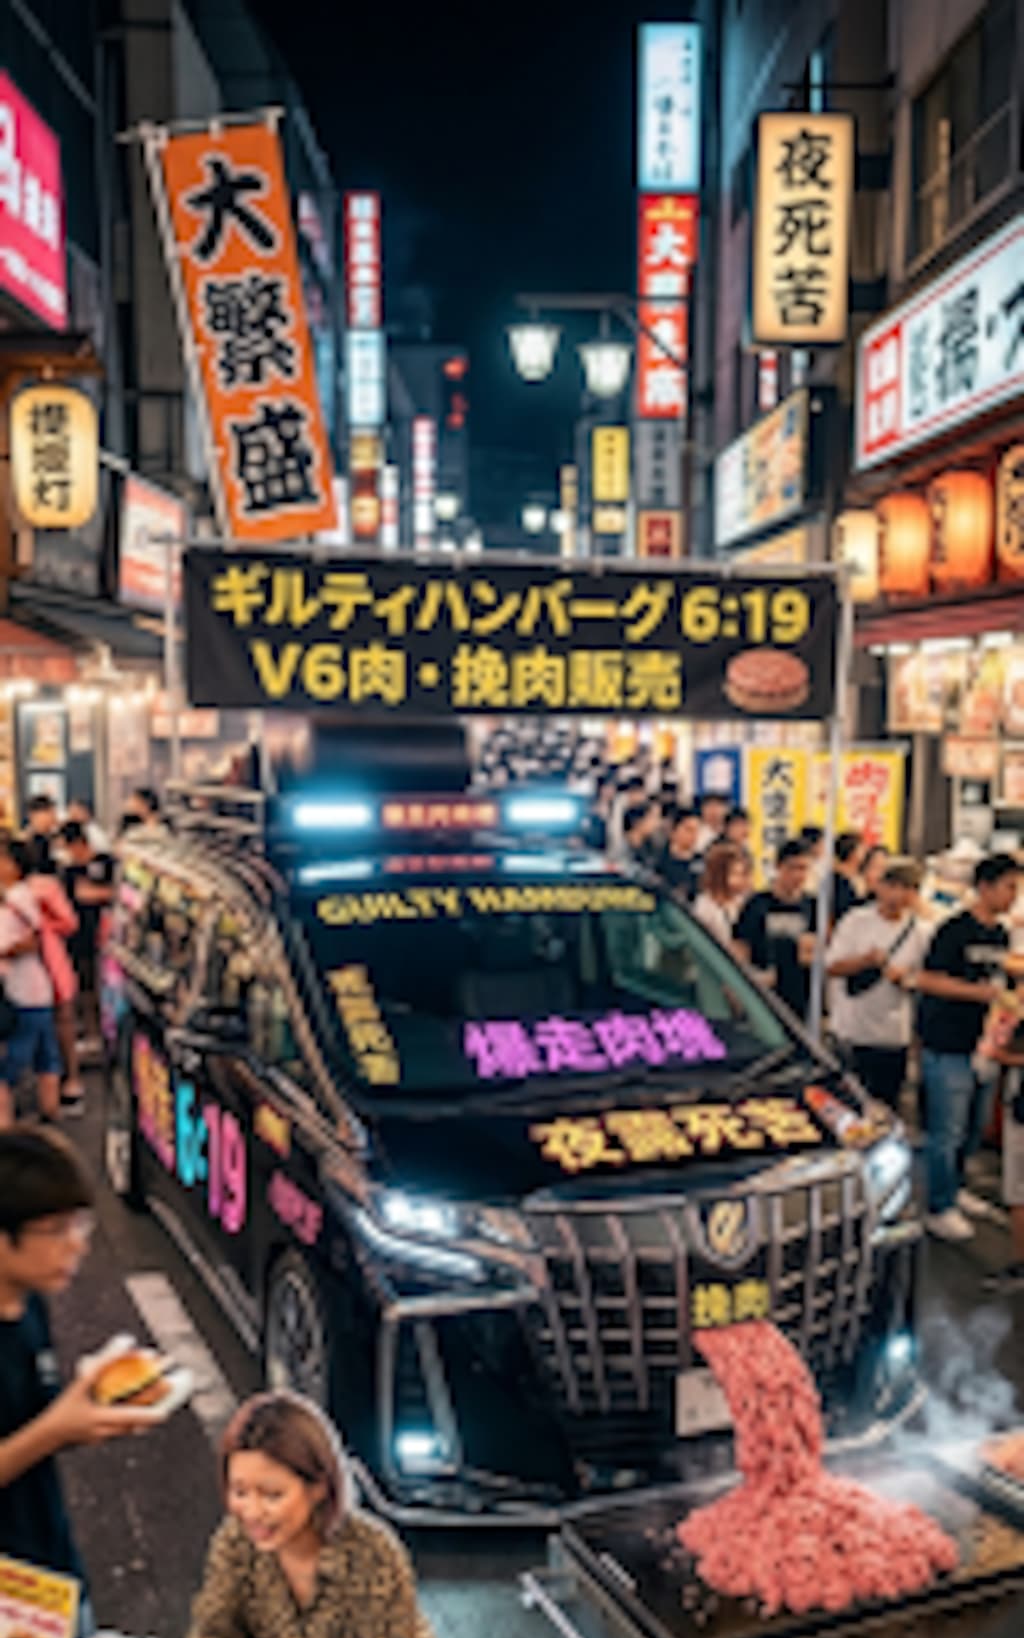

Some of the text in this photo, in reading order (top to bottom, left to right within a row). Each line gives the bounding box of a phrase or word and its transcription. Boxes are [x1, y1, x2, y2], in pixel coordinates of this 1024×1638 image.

[775, 128, 833, 327] 夜死苦
[184, 157, 320, 514] 大繁盛
[212, 564, 810, 643] ギルティハンバーグ 6:19
[252, 641, 682, 709] V6肉・挽肉販売
